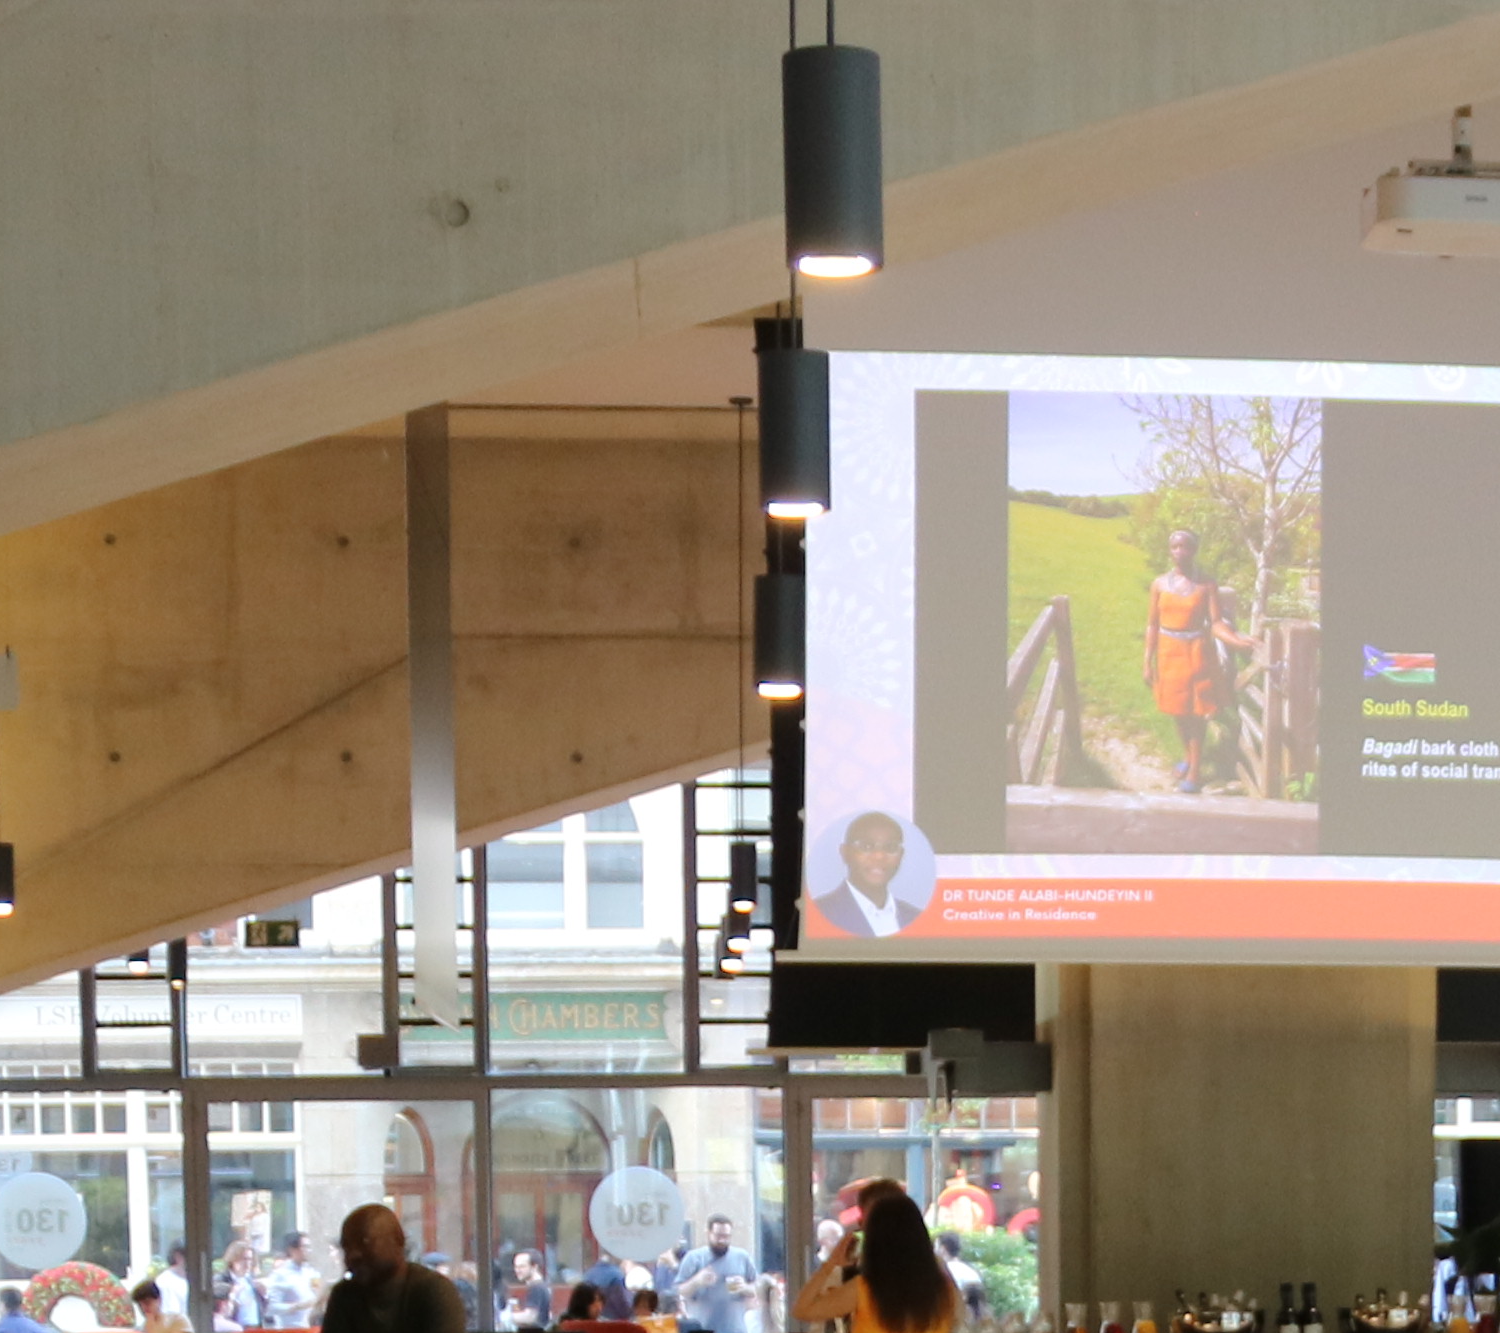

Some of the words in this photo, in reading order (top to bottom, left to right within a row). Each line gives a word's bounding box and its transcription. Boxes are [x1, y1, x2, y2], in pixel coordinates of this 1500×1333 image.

[1362, 698, 1412, 717] South
[1416, 700, 1469, 718] Sudan
[1421, 740, 1457, 756] bark
[1460, 742, 1499, 757] cloth
[1362, 761, 1397, 777] rites
[1401, 762, 1419, 778] of
[1421, 763, 1468, 779] social
[943, 889, 963, 902] DR
[966, 889, 1015, 902] TUNDE
[1018, 889, 1141, 902] ALABI-HUNDEYIN
[943, 908, 1005, 921] Creative
[1008, 908, 1021, 921] in
[1025, 908, 1097, 921] Residence
[96, 1001, 212, 1025] Volunter
[213, 1004, 292, 1025] Centre
[508, 998, 660, 1035] CHAMBERS
